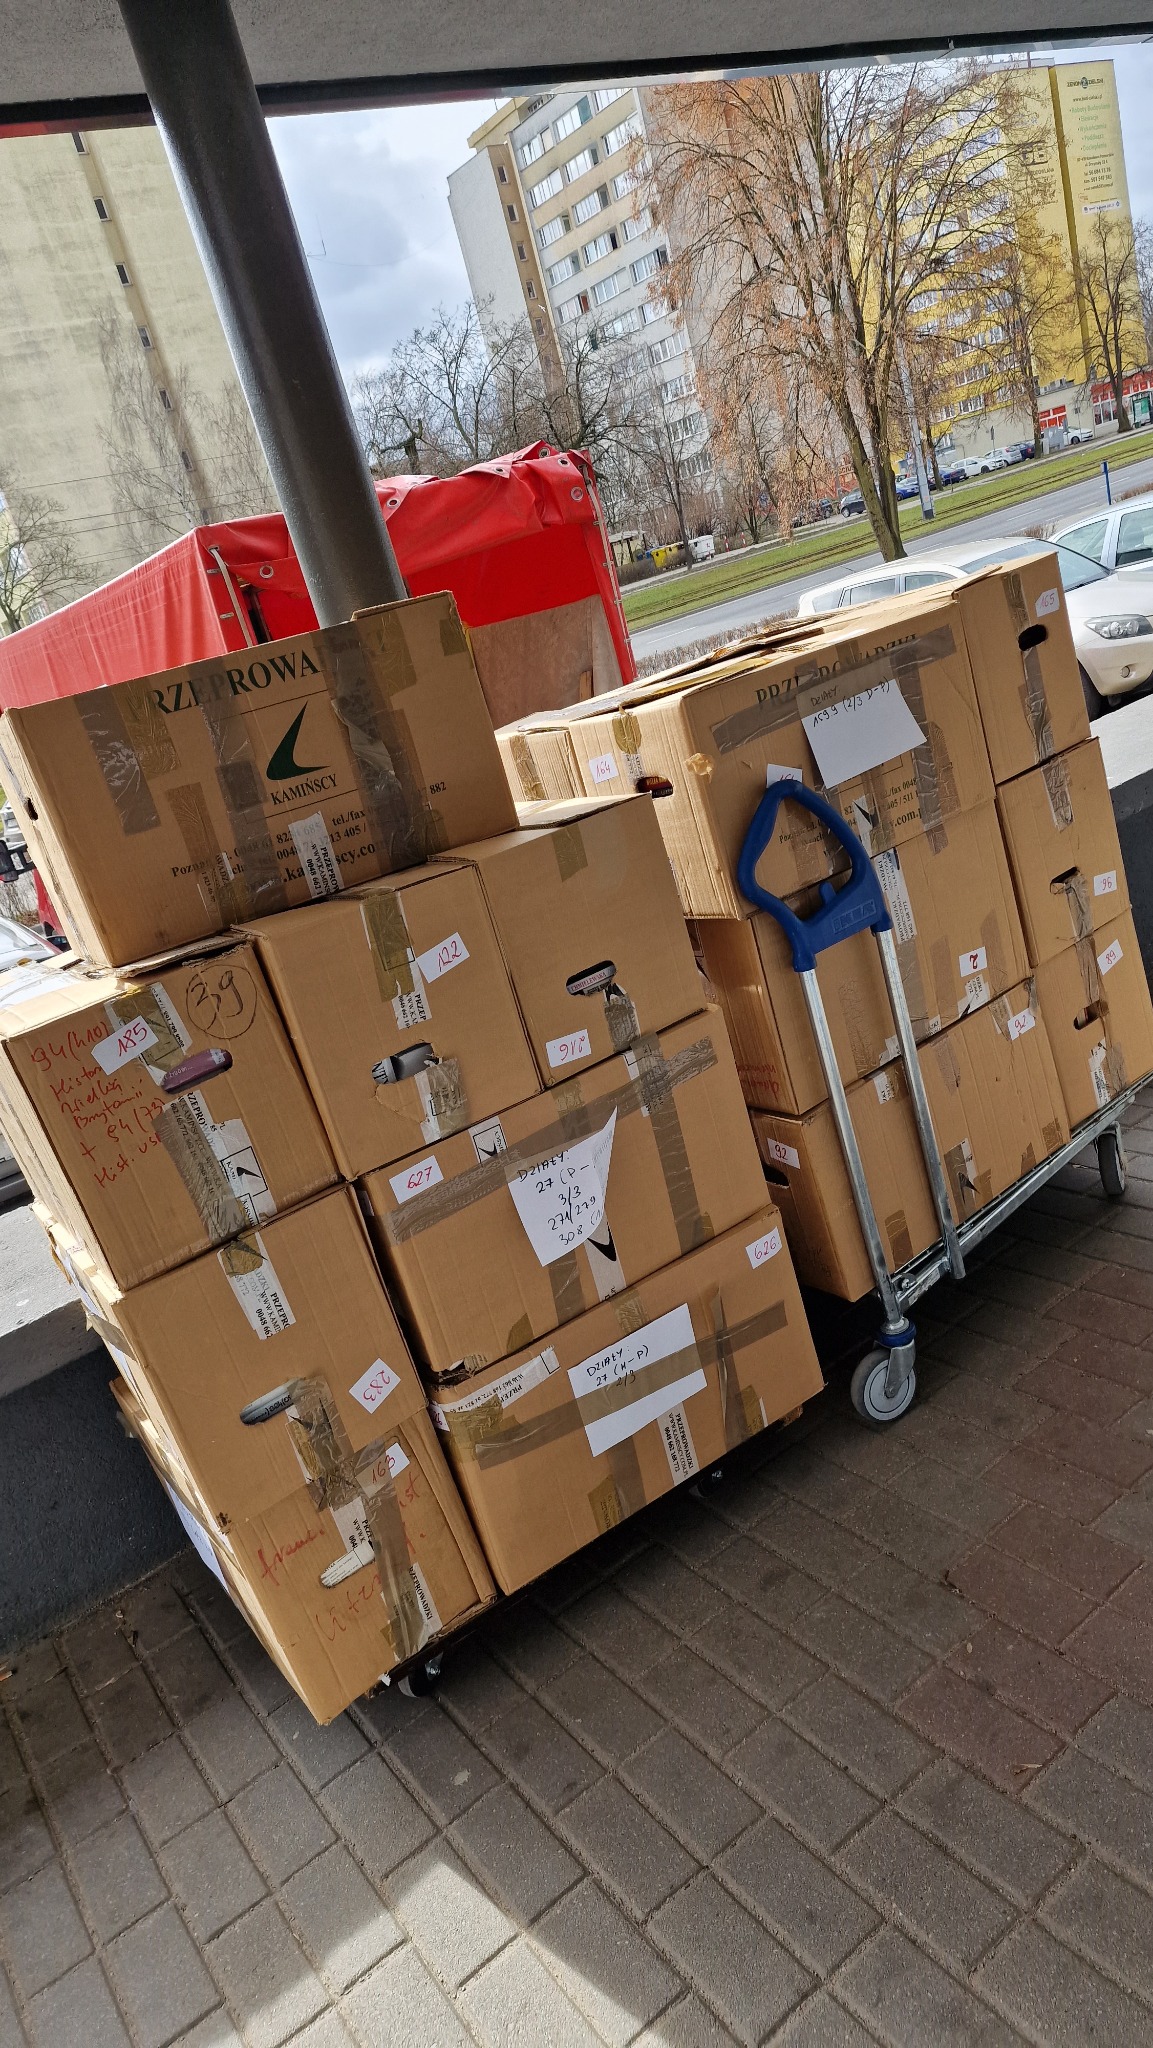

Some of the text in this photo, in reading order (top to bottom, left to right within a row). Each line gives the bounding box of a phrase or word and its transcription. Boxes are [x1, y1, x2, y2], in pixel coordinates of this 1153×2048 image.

[596, 760, 611, 778] 164
[270, 773, 338, 806] KAMIŃSCY
[430, 782, 447, 795] 882
[344, 826, 361, 839] 405
[437, 940, 462, 973] 122
[969, 953, 979, 969] 2
[118, 1022, 148, 1057] 185
[775, 1144, 788, 1161] 92
[407, 1166, 433, 1190] 627
[535, 1178, 554, 1194] 27
[255, 1308, 268, 1326] 0048
[363, 1370, 391, 1402] 283
[596, 1374, 608, 1387] 27
[615, 1370, 637, 1388] 2/3
[371, 1455, 396, 1484] 163
